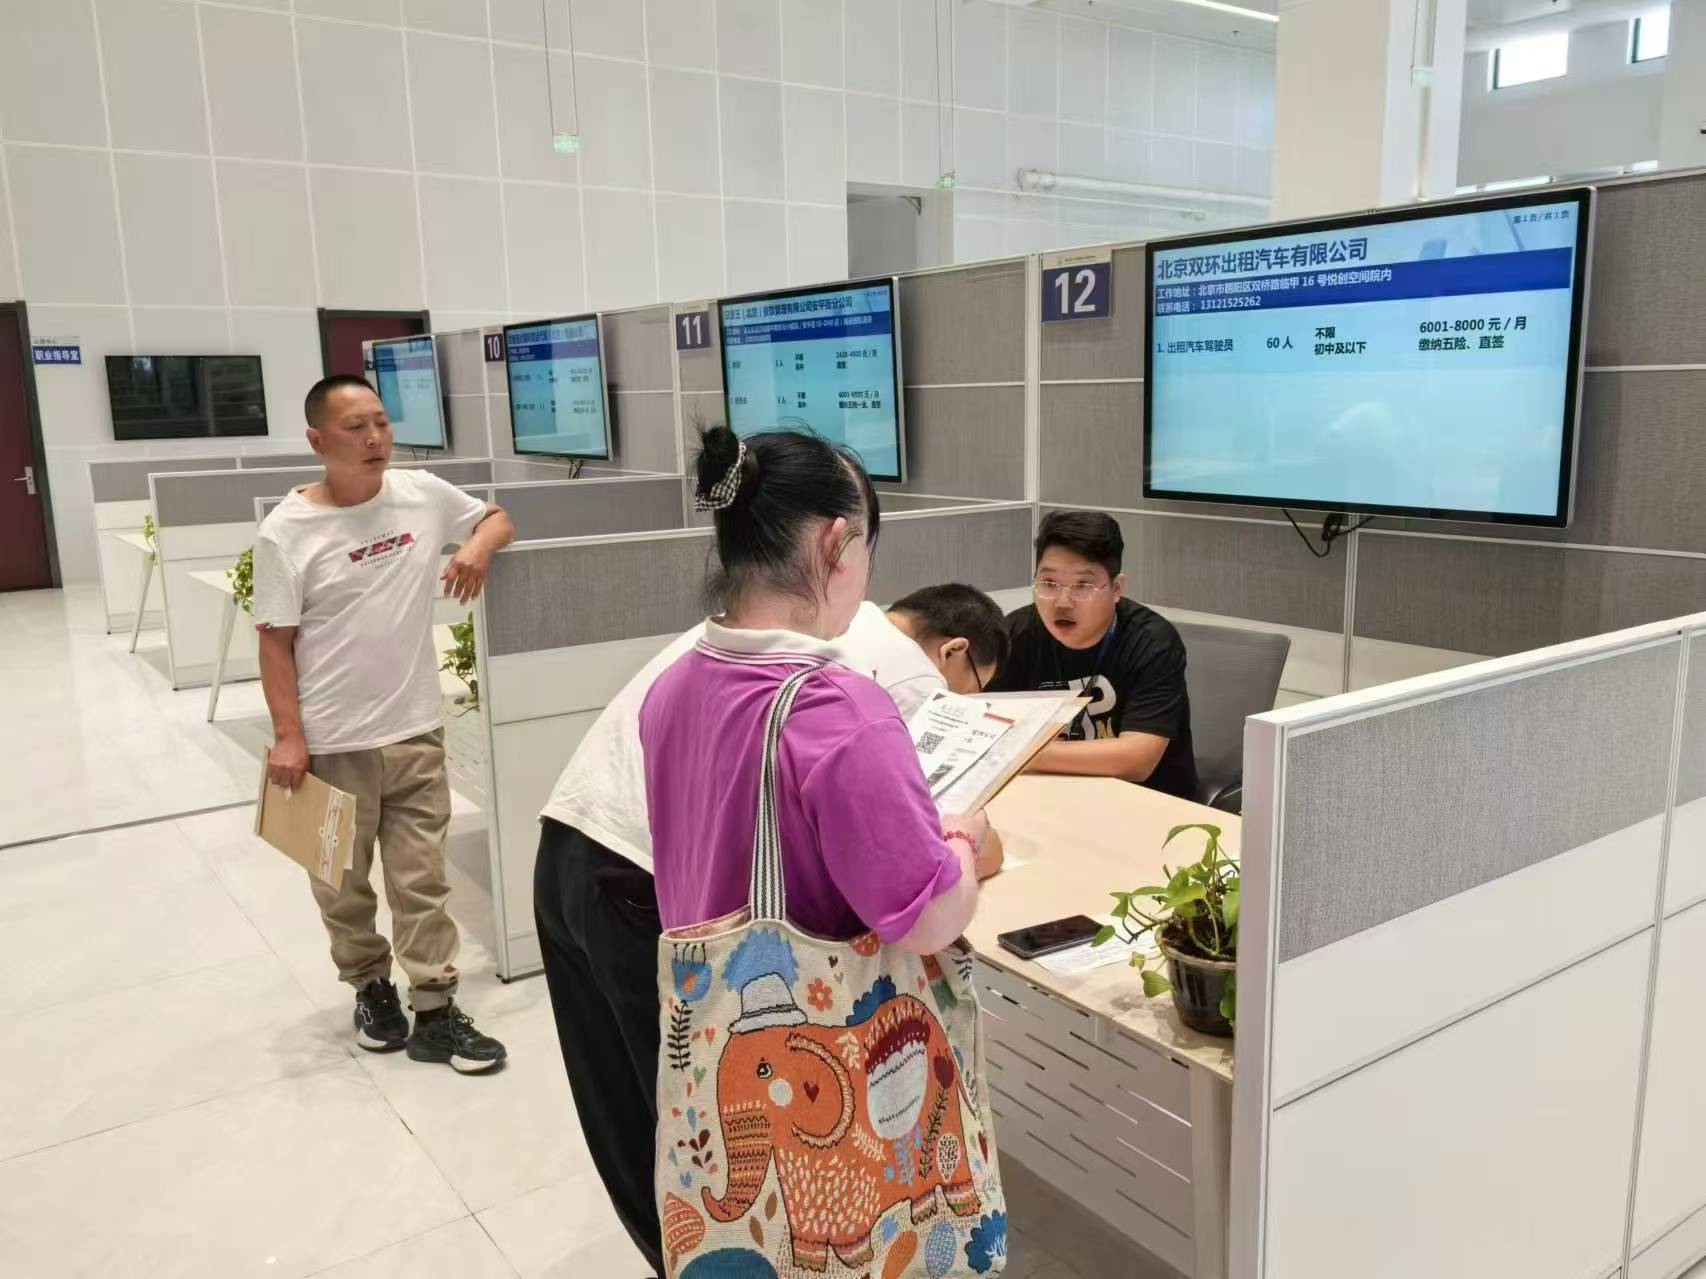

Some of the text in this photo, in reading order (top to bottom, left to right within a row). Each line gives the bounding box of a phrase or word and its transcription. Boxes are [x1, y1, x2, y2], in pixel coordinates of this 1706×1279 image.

[1158, 237, 1368, 280] 北京双环出租汽车有限公司
[1055, 269, 1096, 314] 12
[682, 315, 702, 345] 11
[1315, 327, 1336, 340] 不限
[1419, 318, 1485, 333] 6001-8000
[35, 350, 79, 360] 职业指导室
[487, 335, 501, 360] 10
[1314, 341, 1367, 355] 初中及以下
